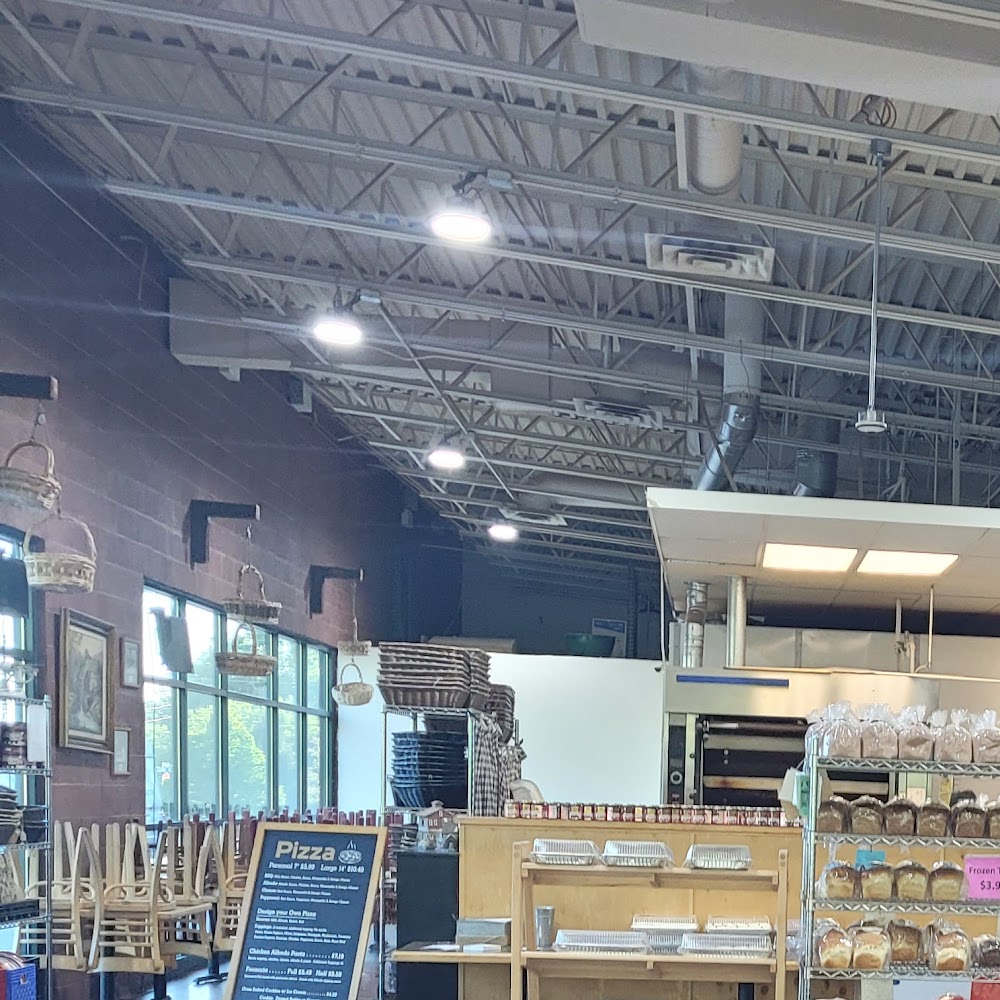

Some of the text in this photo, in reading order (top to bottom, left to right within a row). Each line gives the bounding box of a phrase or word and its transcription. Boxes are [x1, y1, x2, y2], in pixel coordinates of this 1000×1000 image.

[275, 840, 336, 861] Pizza
[269, 862, 292, 870] Personal
[321, 864, 337, 872] Large
[969, 867, 995, 875] Frozen
[257, 908, 275, 916] Design
[249, 948, 270, 956] Chicken
